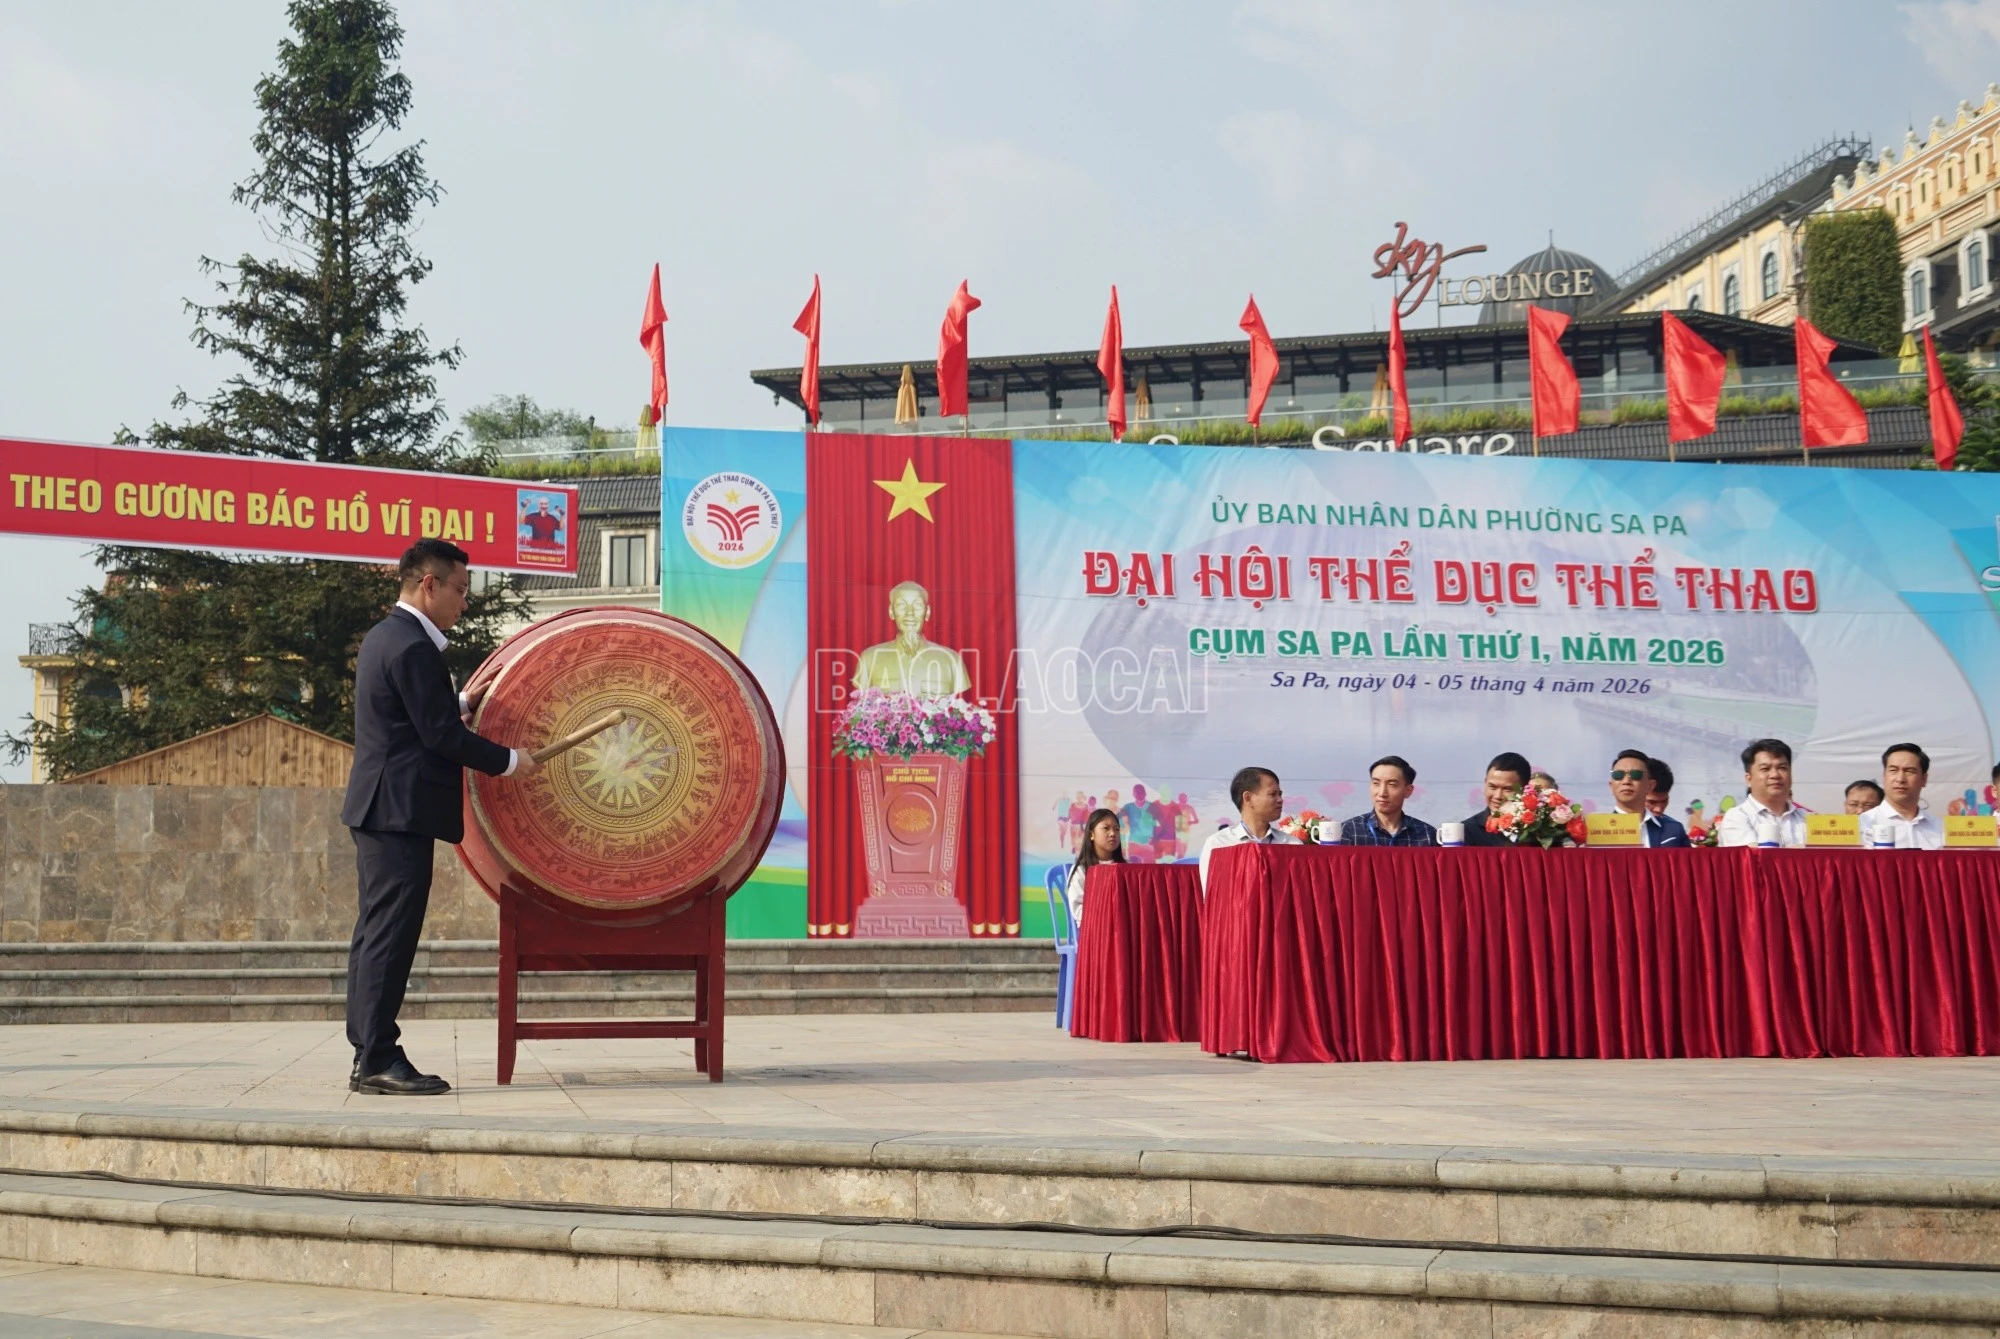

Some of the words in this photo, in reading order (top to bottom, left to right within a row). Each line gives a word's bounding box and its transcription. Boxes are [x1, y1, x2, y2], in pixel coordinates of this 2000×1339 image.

[1439, 268, 1595, 306] LOUNGE
[10, 474, 101, 513] THEO
[115, 481, 235, 523] GƯƠNG
[247, 488, 315, 530] BÁC
[326, 490, 369, 534] HỒ
[381, 499, 411, 536] VĨ
[420, 507, 474, 547] ĐẠI
[1211, 494, 1249, 523] ỦY
[1258, 503, 1316, 525] BAN
[1326, 502, 1409, 528] NHÂN
[1418, 503, 1477, 530] DÂN
[1486, 505, 1602, 533] PHƯỜNG
[1611, 514, 1645, 534] SA
[1653, 515, 1688, 535] PA
[719, 543, 744, 551] 2026
[1083, 551, 1176, 608] ĐẠI
[1193, 544, 1292, 610] HỘI
[1308, 540, 1415, 602] THỂ
[1433, 559, 1539, 615] DỤC
[1555, 547, 1659, 609] THỂ
[1674, 567, 1818, 613] THAO
[1189, 627, 1266, 660] CỤM
[1276, 629, 1321, 656] SA
[1330, 630, 1374, 658] PA
[1383, 624, 1448, 659] LẦN
[1458, 628, 1521, 660] THỨ
[1531, 636, 1551, 664] I,
[1562, 632, 1637, 663] NĂM
[1647, 638, 1725, 665] 2026
[1270, 671, 1295, 688] Sa
[1301, 672, 1329, 691] Pa,
[1337, 671, 1385, 693] ngày
[1392, 673, 1416, 690] 04
[1438, 674, 1463, 691] 05
[1469, 674, 1526, 695] tháng
[1533, 677, 1545, 692] 4
[1552, 677, 1595, 694] năm
[1601, 679, 1650, 695] 2026
